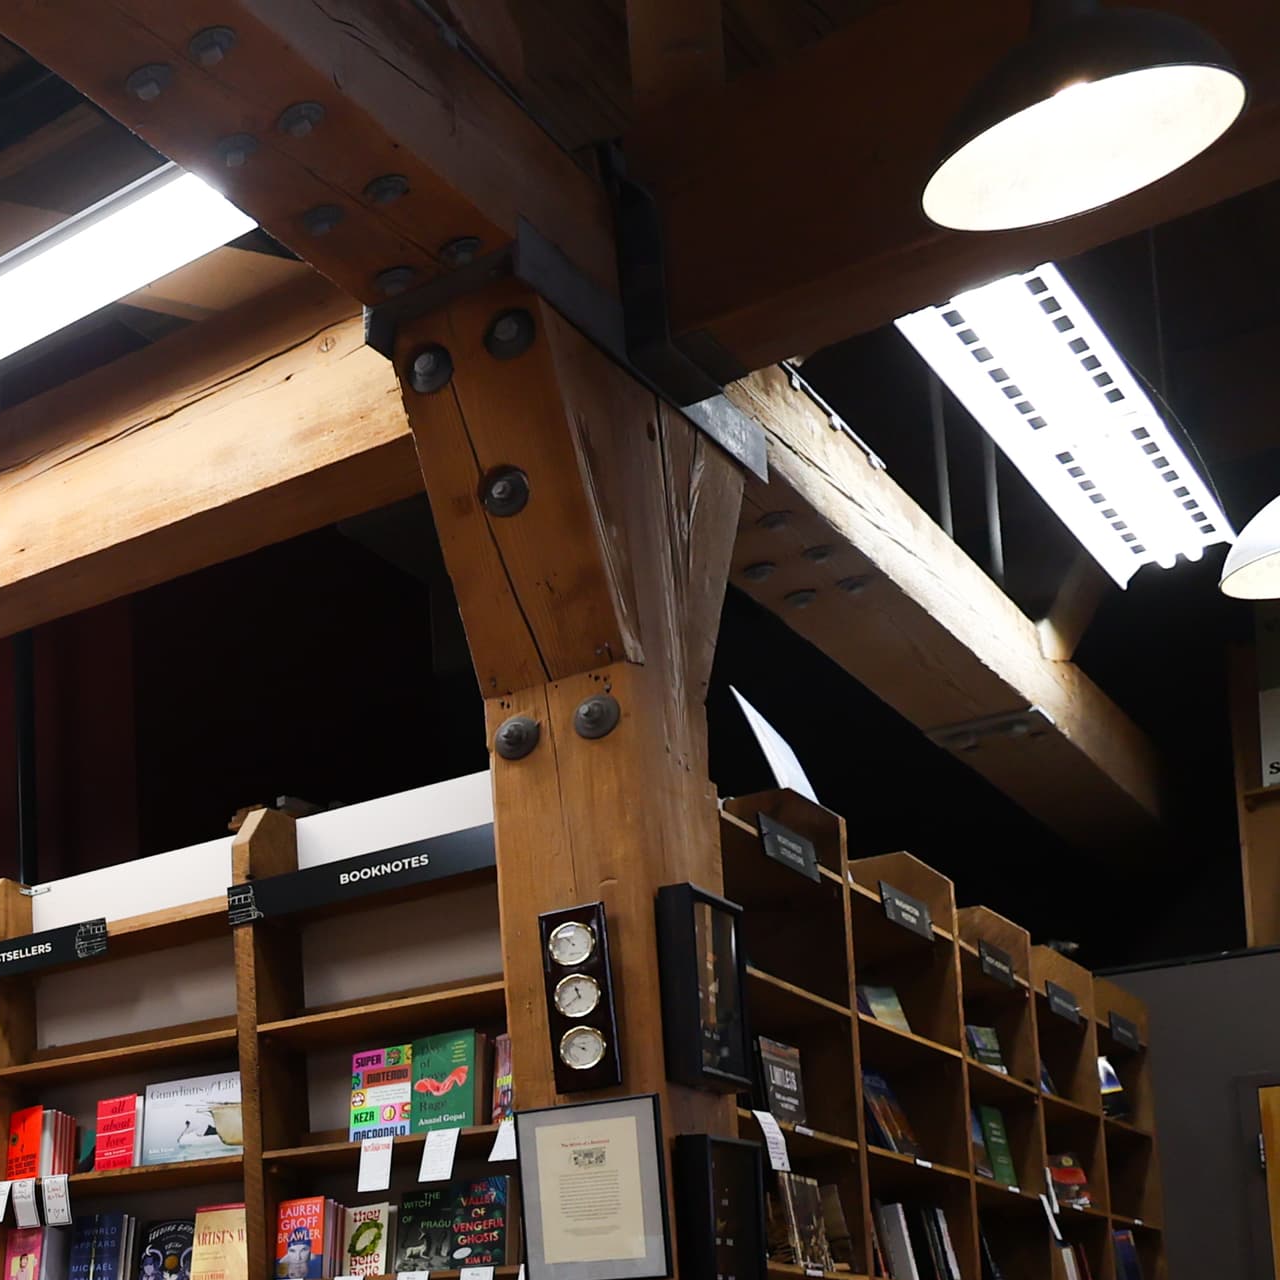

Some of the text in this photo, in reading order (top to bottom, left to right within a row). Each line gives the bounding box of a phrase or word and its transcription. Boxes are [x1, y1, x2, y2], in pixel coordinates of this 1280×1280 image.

[339, 854, 429, 885] BOOKNOTES
[418, 1112, 466, 1126] Anand Gopal
[280, 1203, 320, 1219] LAUREN
[281, 1217, 318, 1231] GROFF
[278, 1229, 321, 1243] BRAWLER
